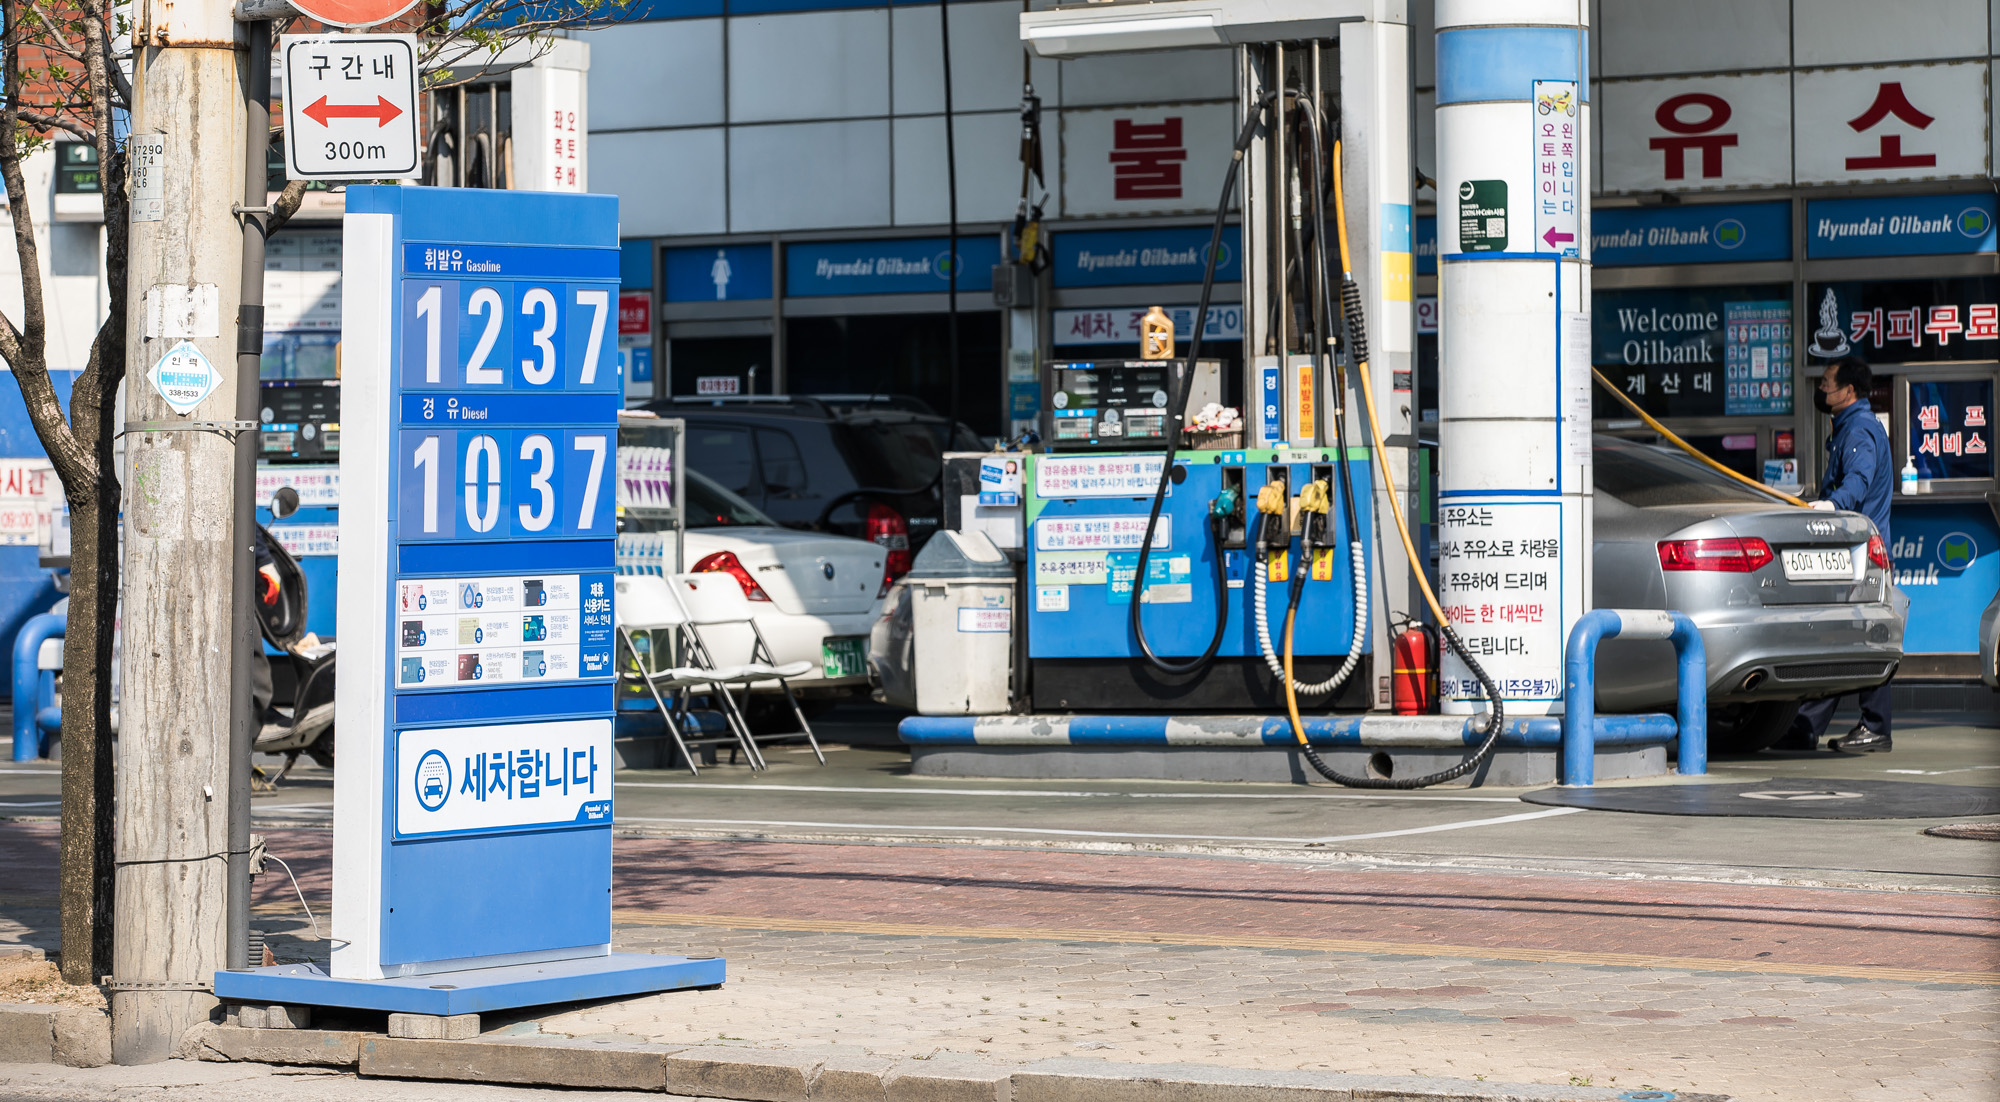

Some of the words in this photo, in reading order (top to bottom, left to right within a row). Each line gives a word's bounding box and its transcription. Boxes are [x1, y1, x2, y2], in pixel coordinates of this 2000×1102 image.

[308, 54, 394, 80] 구간내
[1649, 93, 1739, 181] 유
[1845, 82, 1937, 171] 소
[138, 156, 155, 166] 174
[325, 141, 386, 160] 300m
[1109, 117, 1188, 200] 불
[1541, 122, 1558, 215] 오토바이는
[1561, 122, 1575, 215] 왼쪽입니다
[1591, 228, 1645, 253] yundai
[1647, 225, 1710, 246] Oilbank
[1817, 216, 1885, 241] Hyundai
[1888, 214, 1953, 235] Oilbank
[424, 248, 463, 271] 휘발유
[466, 258, 501, 272] Gasoline
[816, 257, 875, 280] Hyundai
[876, 256, 931, 276] Oilbank
[1077, 249, 1139, 272] Hyundai
[1140, 246, 1198, 267] Oilbank
[1070, 311, 1121, 339] 세차,
[1128, 309, 1193, 337] 주를
[1617, 307, 1719, 333] Welcome
[1850, 304, 1999, 348] 커피무료
[416, 285, 609, 386] 1237
[1623, 338, 1714, 366] Oilbank
[168, 389, 199, 398] 338-1533
[1627, 371, 1713, 395] 계산대
[422, 397, 459, 420] 경유
[461, 406, 488, 420] Diesel
[1265, 375, 1278, 419] 경유
[1917, 405, 1986, 430] 셀프
[1918, 432, 1987, 457] 서비스
[0, 468, 45, 496] 시간
[413, 433, 608, 533] 1037
[1447, 508, 1493, 528] 주유소는
[1463, 539, 1515, 559] 주유소로
[1520, 538, 1559, 559] 차량을
[1818, 552, 1847, 571] 1650
[590, 582, 605, 598] 제휴
[1450, 572, 1499, 592] 주유하여
[1504, 571, 1548, 591] 드리며
[583, 598, 611, 614] 신용카드
[1480, 603, 1495, 623] 한
[1500, 603, 1544, 624] 대씩만
[1469, 636, 1529, 656] 드립니다.
[1486, 679, 1559, 697] 시주유불가)
[460, 745, 598, 802] 세차합니다
